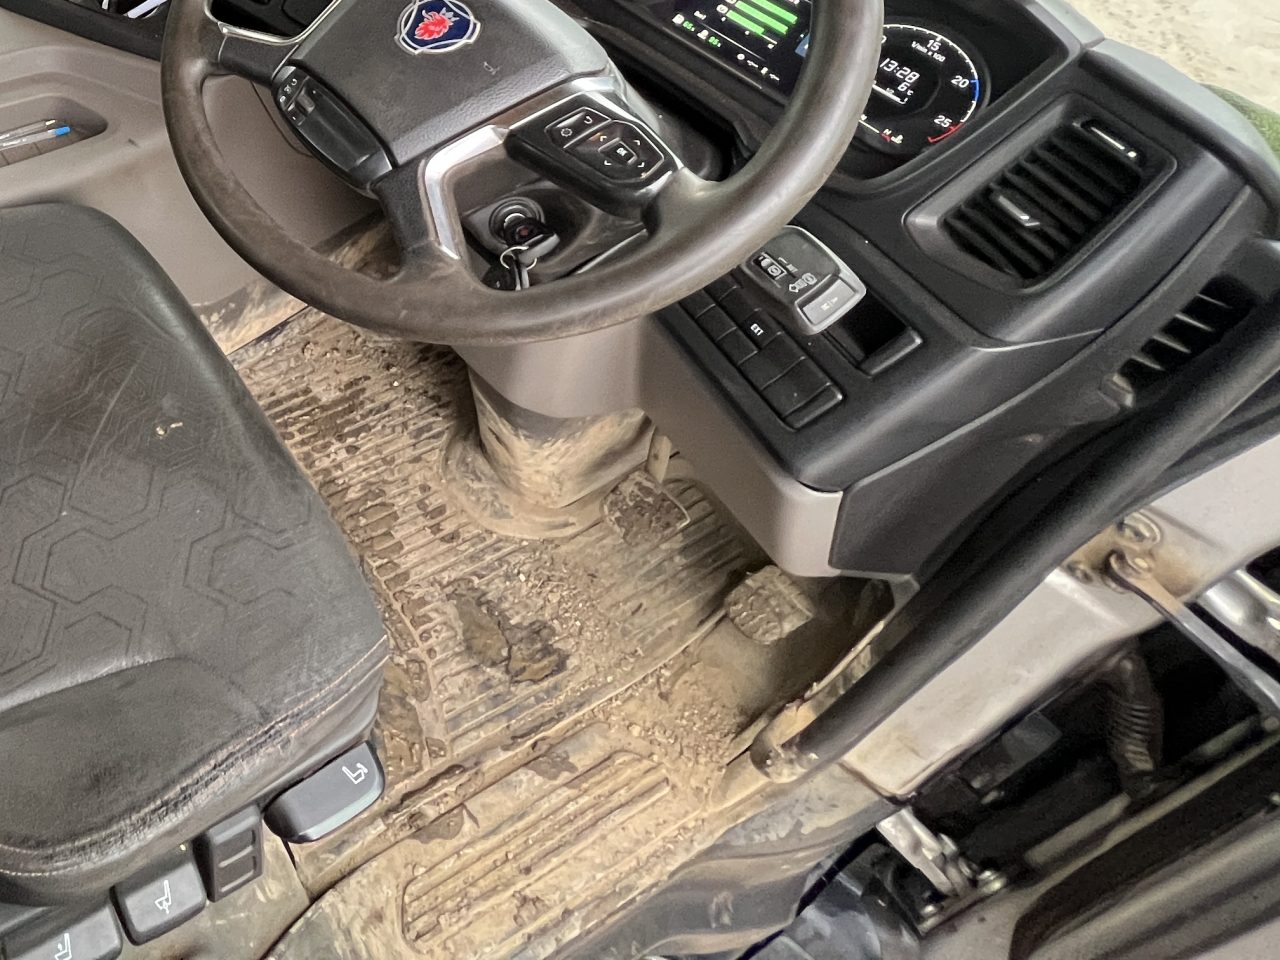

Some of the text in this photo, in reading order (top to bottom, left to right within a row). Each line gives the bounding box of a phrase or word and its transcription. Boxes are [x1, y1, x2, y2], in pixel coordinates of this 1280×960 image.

[927, 39, 942, 51] 15
[879, 58, 920, 83] 13:28
[951, 75, 969, 88] 20
[933, 115, 952, 128] 25
